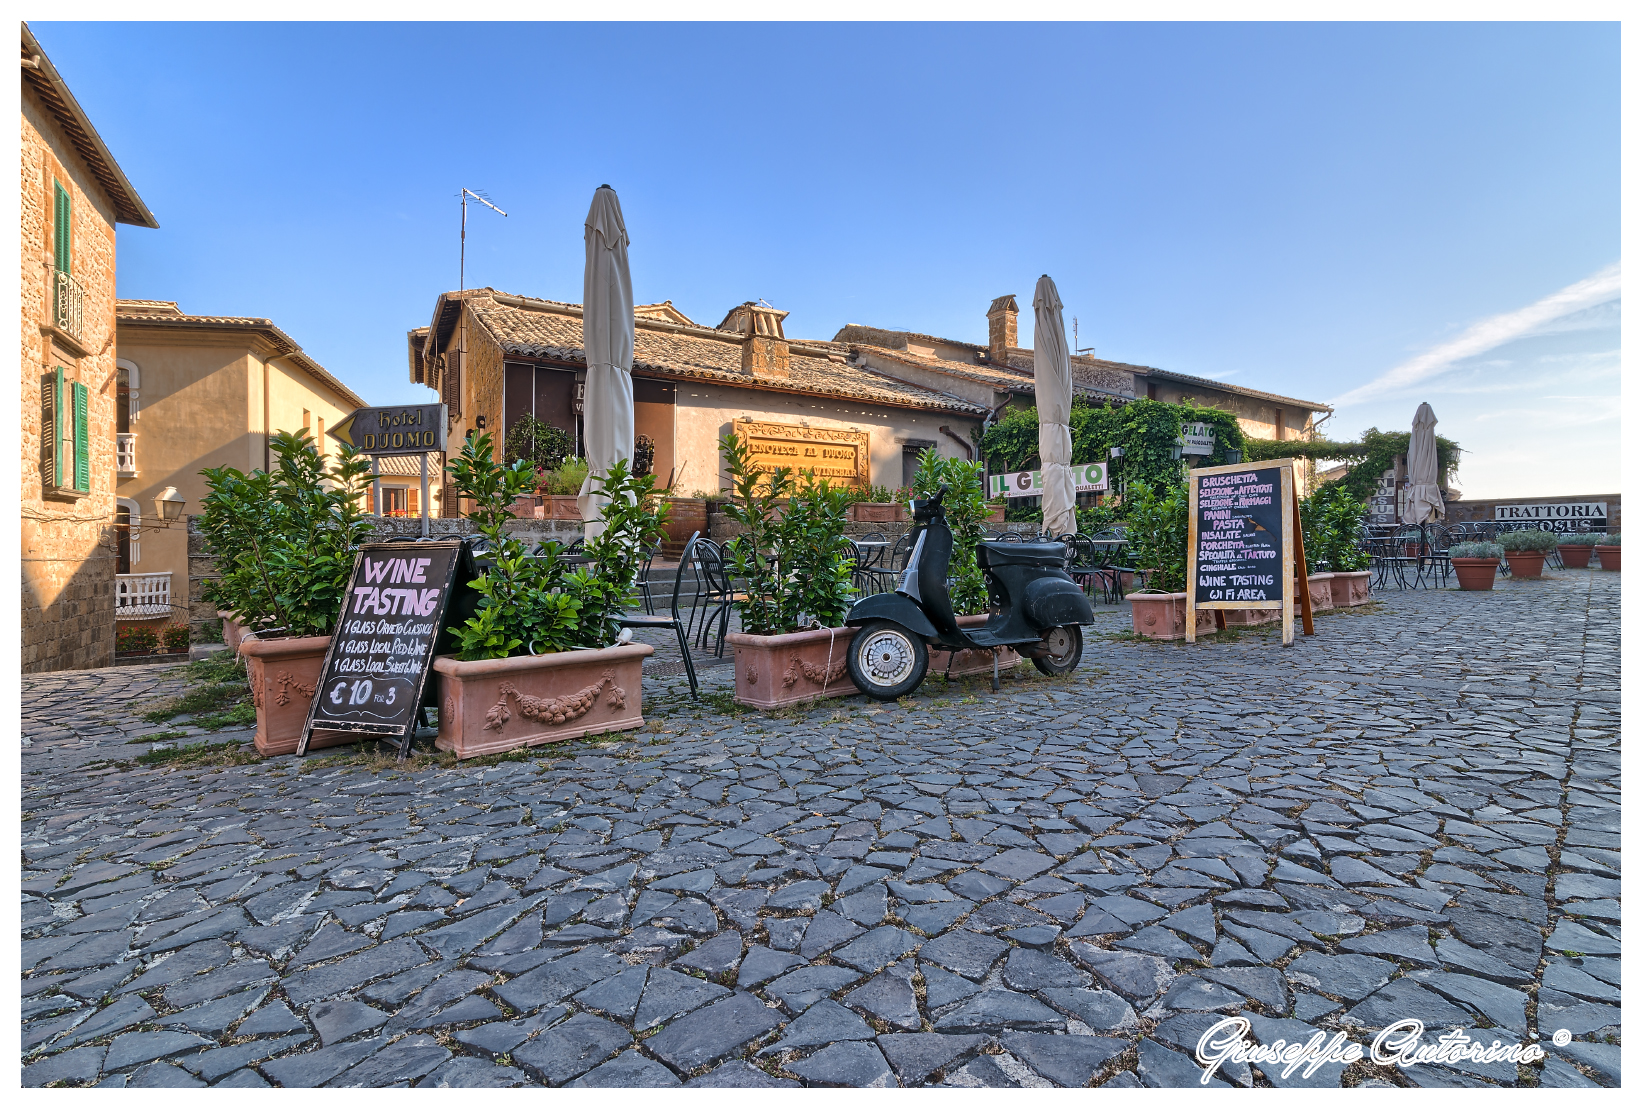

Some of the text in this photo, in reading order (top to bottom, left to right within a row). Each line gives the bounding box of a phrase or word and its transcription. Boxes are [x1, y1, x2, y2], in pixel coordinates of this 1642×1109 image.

[378, 409, 422, 430] Hotel
[1182, 424, 1215, 437] GELATO
[364, 430, 434, 450] DUOMO
[750, 443, 856, 460] ENOTECA AL DUOMO
[992, 475, 1010, 493] IL
[1017, 464, 1103, 491] GETO
[1202, 473, 1258, 488] BRUSCHETTA
[1199, 486, 1235, 498] SELEZIONE
[1239, 483, 1273, 495] AFFETTATI
[1199, 498, 1234, 509] SELEZIONE
[1239, 496, 1272, 506] FORMAGGI
[1377, 479, 1388, 523] NOSUS
[1203, 509, 1231, 521] PANINI
[1496, 504, 1606, 519] TRATTORIA
[1213, 519, 1245, 531] PASTA
[1201, 530, 1242, 540] INSALATE
[1200, 540, 1245, 551] PORCHETTA
[1240, 549, 1277, 560] TARTUFO
[364, 556, 432, 584] WINE
[1199, 563, 1237, 572] CINGHIALE
[1199, 574, 1274, 587] WINE TASTING
[353, 586, 441, 617] TASTING
[1209, 589, 1223, 600] WI
[1236, 588, 1267, 600] AREA
[344, 619, 352, 634] 1
[350, 620, 377, 635] GLASS
[402, 618, 434, 636] CLASSICO
[339, 637, 428, 657] 1 GLASS LOCAL RED WINE
[333, 658, 341, 673] 1
[339, 657, 366, 673] GLASS
[365, 655, 387, 674] LOCAL
[329, 681, 348, 705] €
[348, 679, 374, 705] 10
[385, 686, 397, 706] 3
